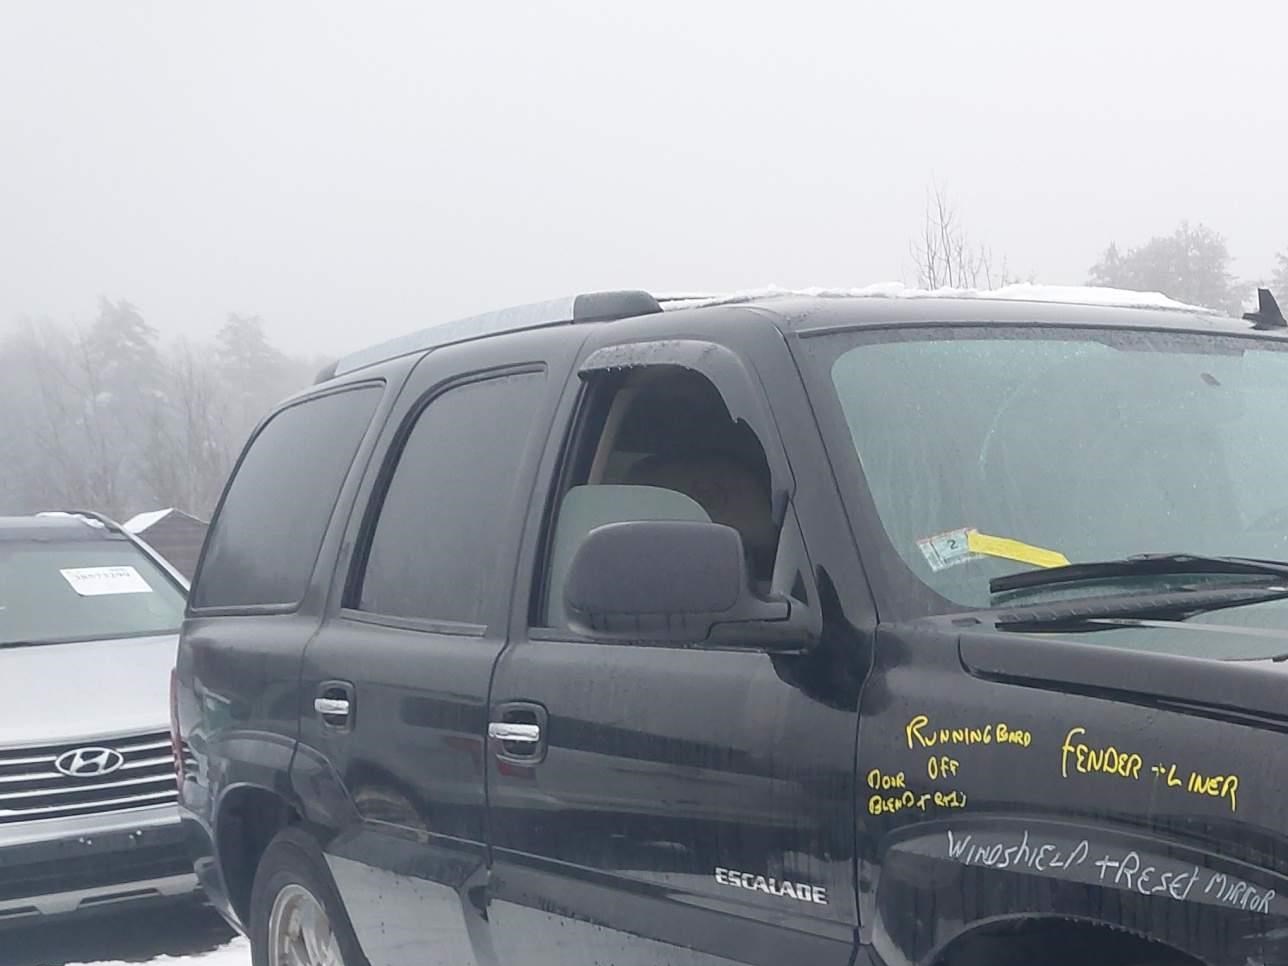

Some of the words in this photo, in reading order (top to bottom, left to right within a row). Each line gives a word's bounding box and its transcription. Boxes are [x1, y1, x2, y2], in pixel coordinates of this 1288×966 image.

[906, 715, 993, 749] RUNNING
[927, 756, 960, 780] OFF
[1062, 727, 1142, 780] FENDER
[715, 867, 828, 904] ESCALADE
